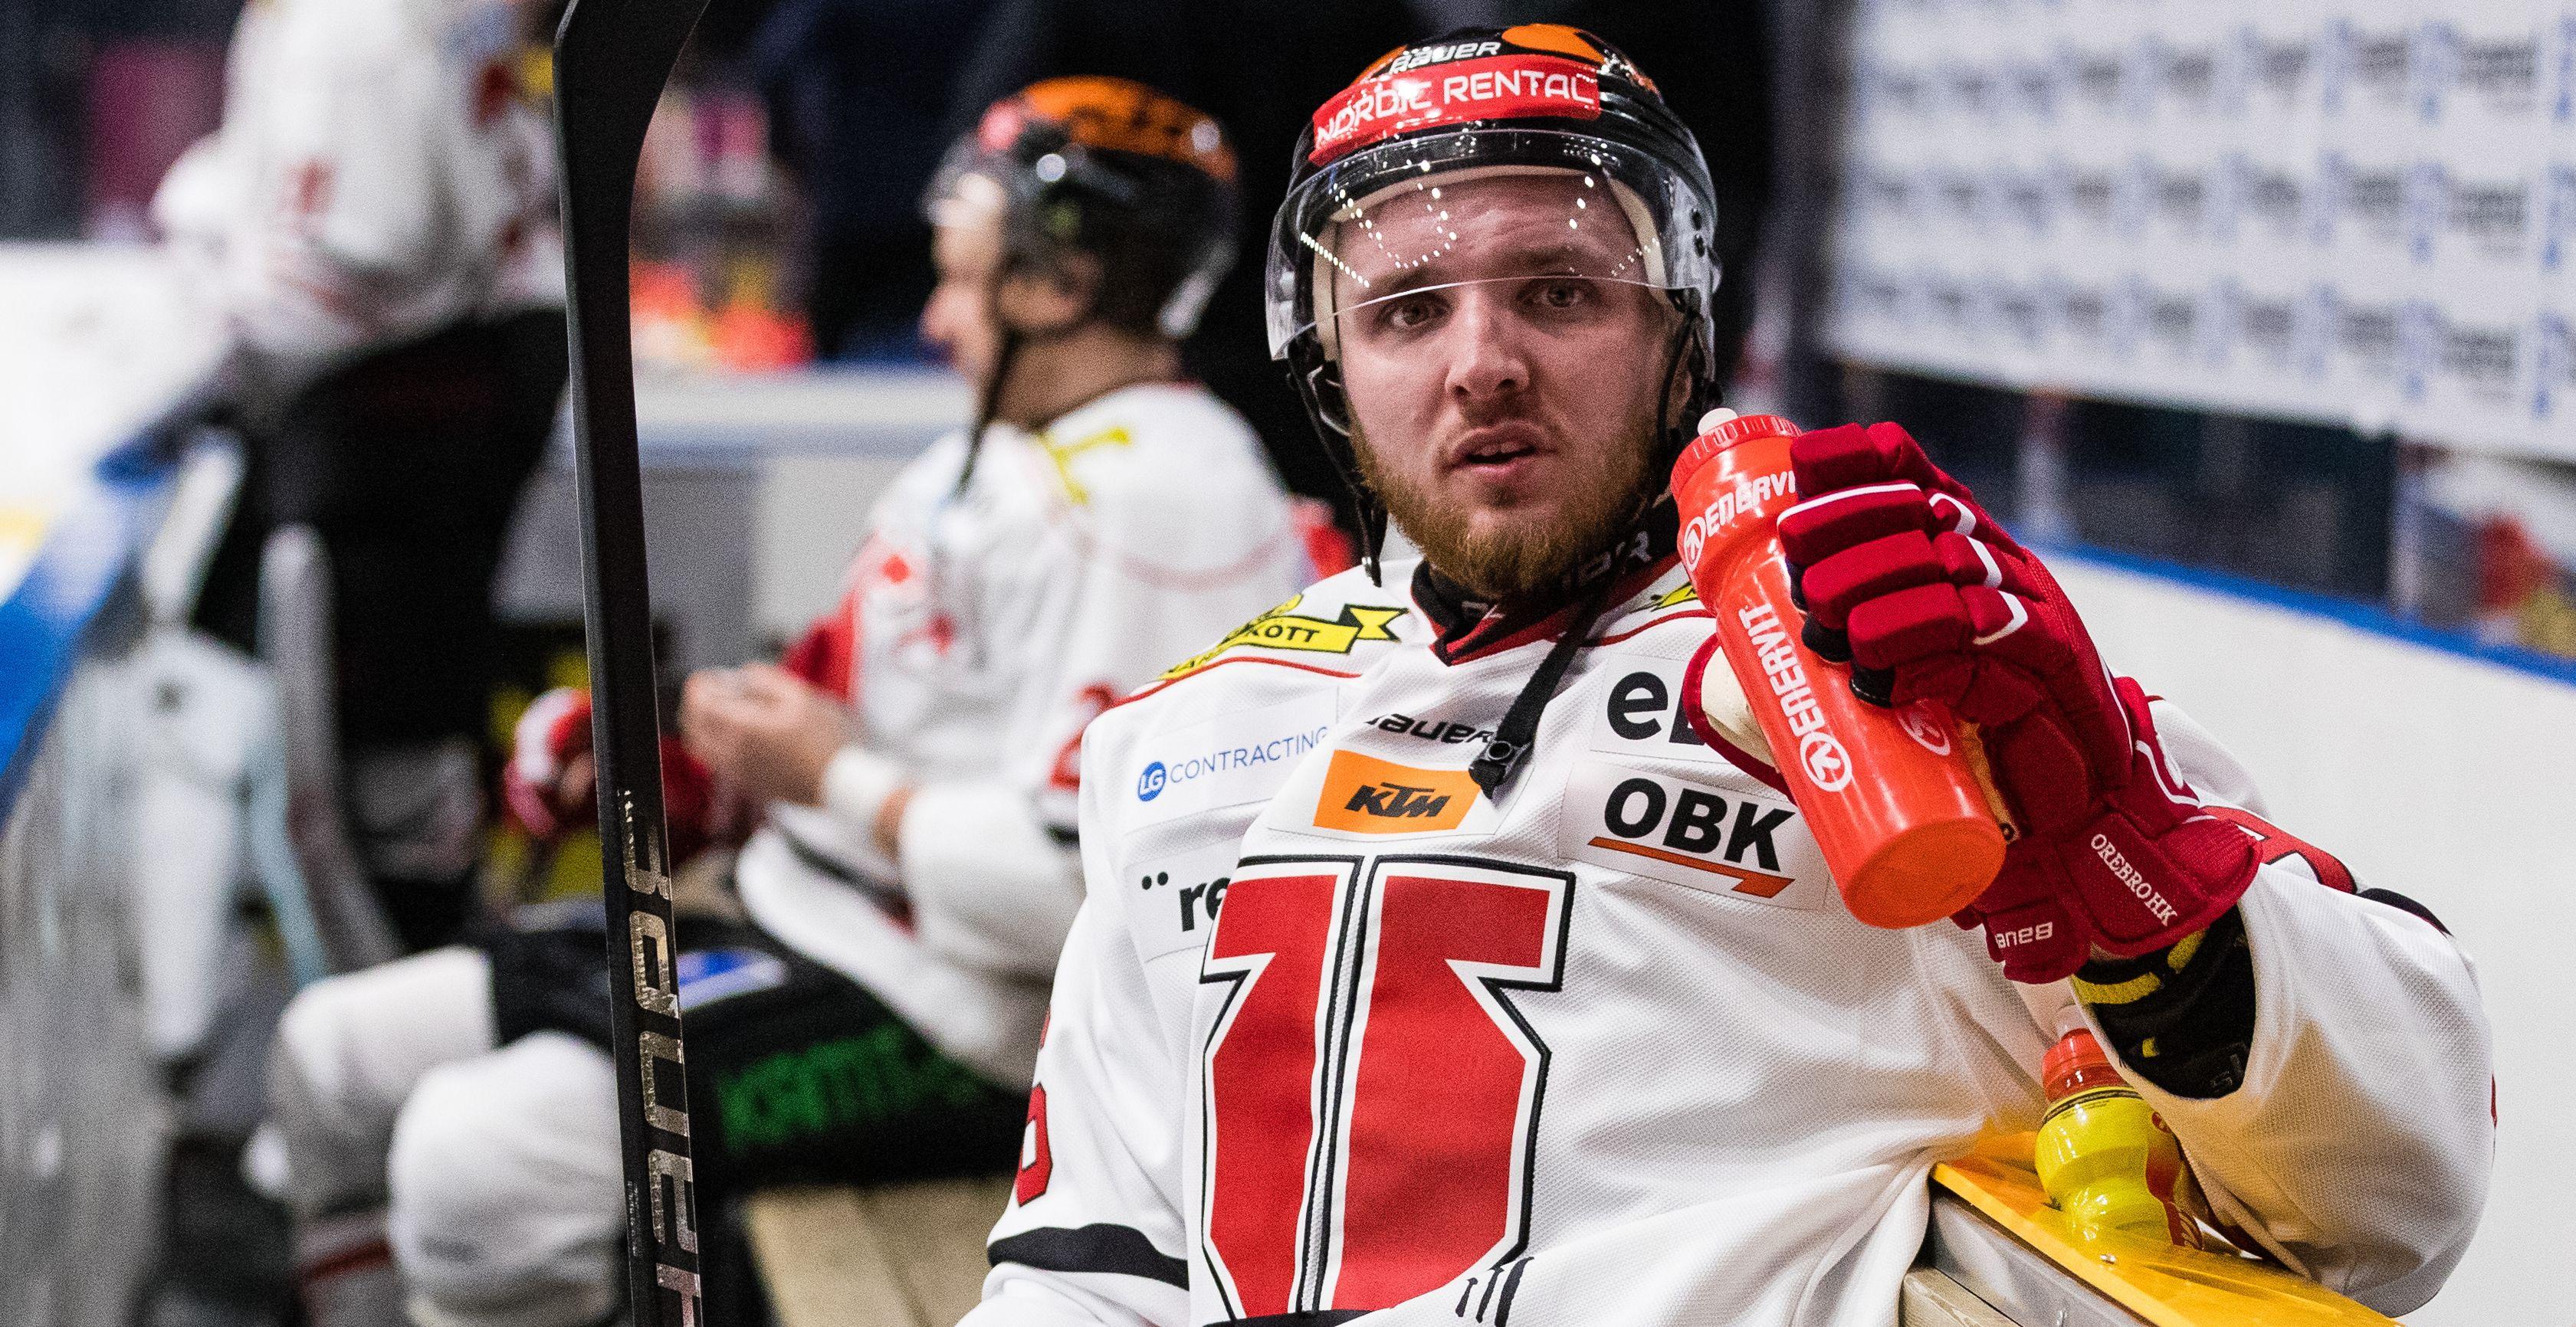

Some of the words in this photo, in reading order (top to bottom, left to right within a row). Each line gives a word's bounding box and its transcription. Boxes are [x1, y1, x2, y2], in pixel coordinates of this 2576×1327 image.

[1316, 81, 1433, 145] NORDIC
[1442, 69, 1596, 105] RENTAL
[1705, 470, 1797, 538] ENERVI
[1738, 603, 1822, 739] ENERVIT
[1344, 781, 1452, 817] KTM
[1603, 777, 1796, 873] OBK
